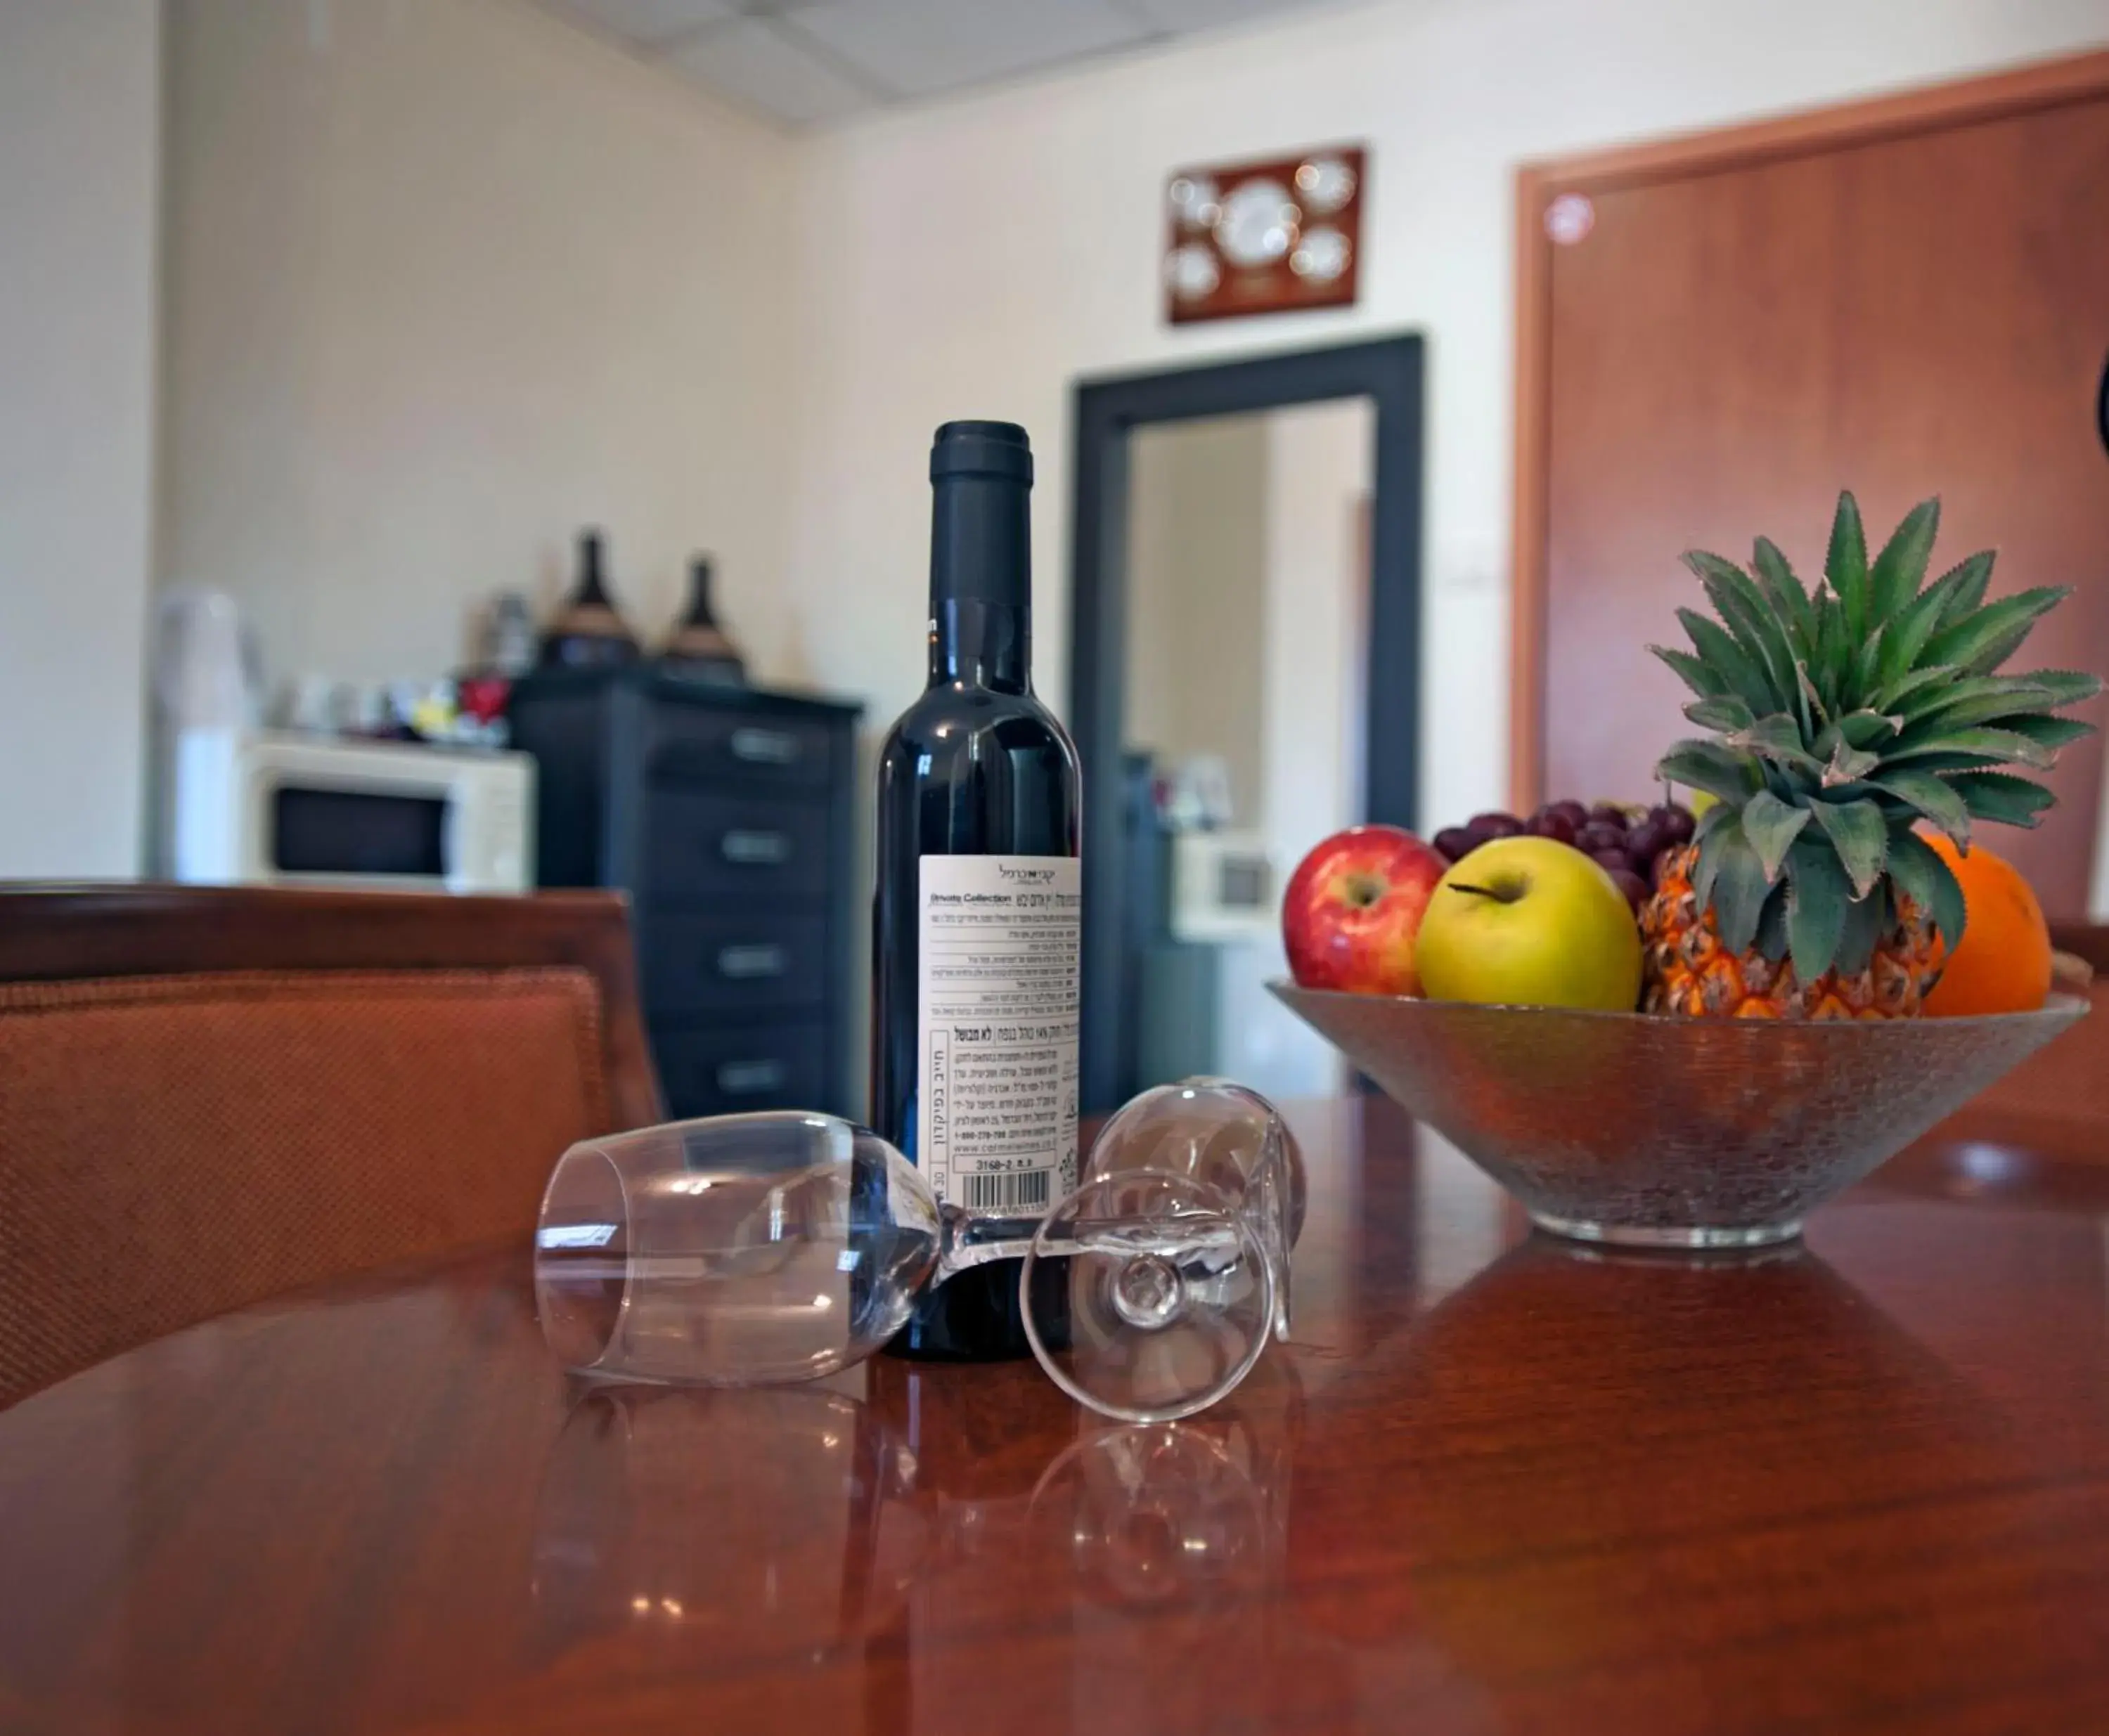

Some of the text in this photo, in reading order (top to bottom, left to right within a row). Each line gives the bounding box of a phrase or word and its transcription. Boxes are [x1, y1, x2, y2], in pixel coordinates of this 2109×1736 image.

[963, 893, 1012, 903] Collection
[934, 1049, 948, 1145] חייב בפיקדון
